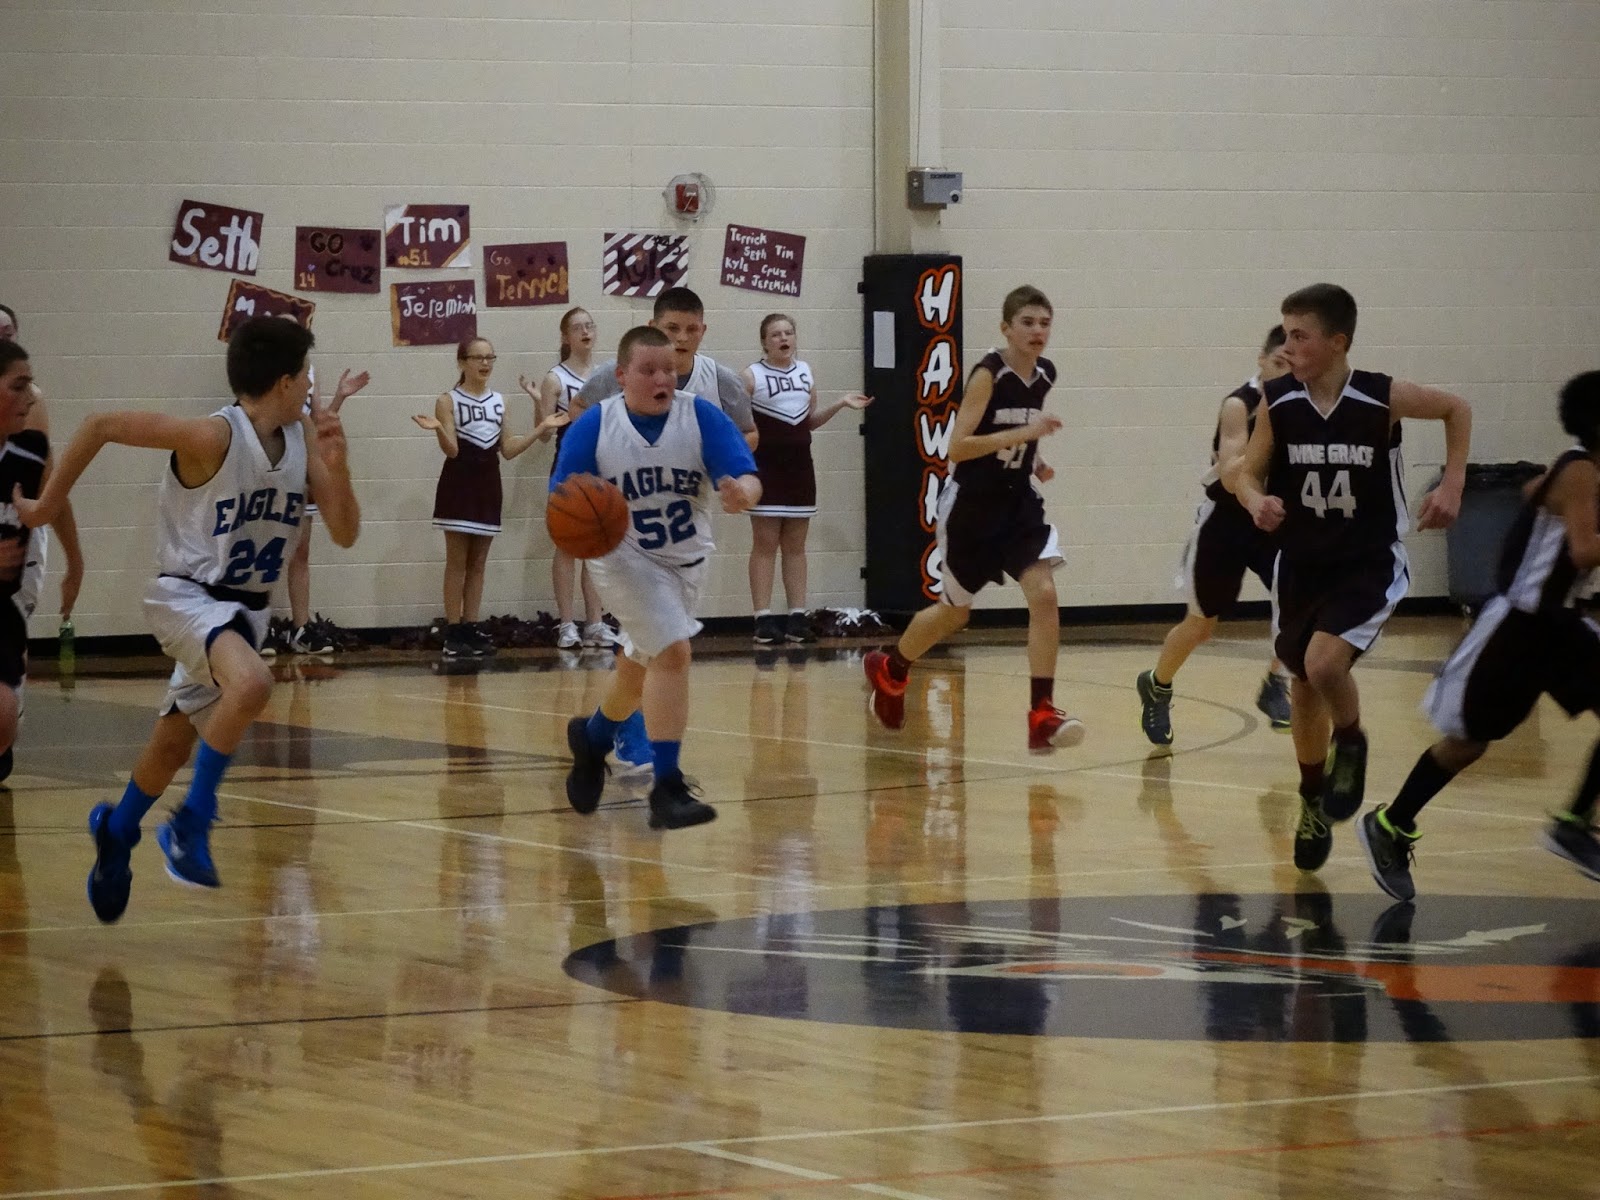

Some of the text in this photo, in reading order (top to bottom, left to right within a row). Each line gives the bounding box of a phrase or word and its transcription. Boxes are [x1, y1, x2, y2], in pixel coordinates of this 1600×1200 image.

[171, 207, 260, 271] Seth
[309, 230, 344, 256] GO
[399, 216, 461, 246] Tim
[489, 250, 512, 266] Go
[299, 271, 316, 288] 14
[495, 265, 569, 301] Terrick
[400, 294, 477, 318] Jeremiah
[765, 372, 811, 398] DGLS
[457, 401, 503, 428] DGLS
[607, 466, 703, 501] AGLES
[1300, 469, 1357, 519] 44
[631, 499, 698, 550] 52
[221, 536, 288, 586] 24
